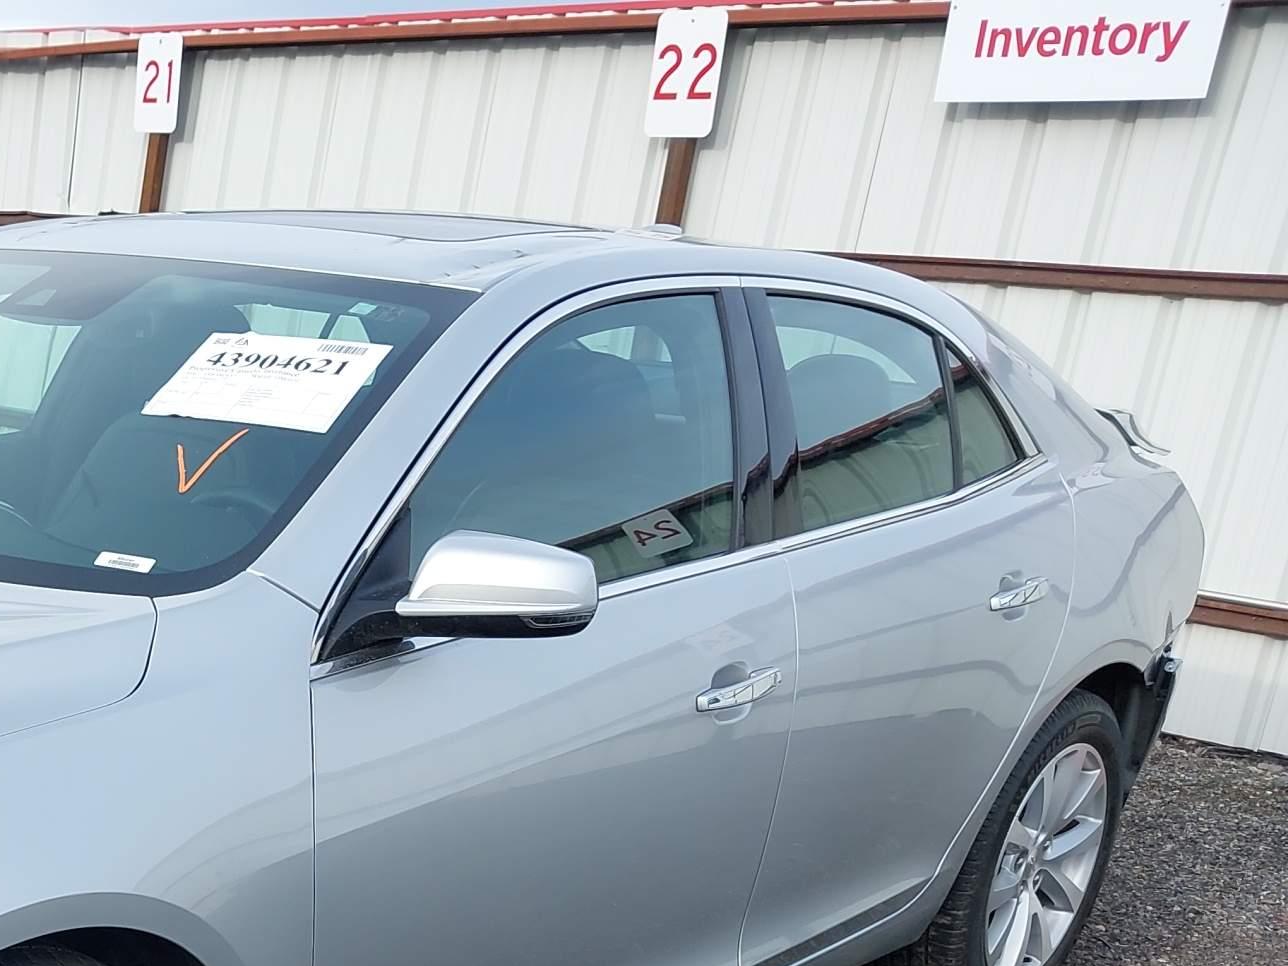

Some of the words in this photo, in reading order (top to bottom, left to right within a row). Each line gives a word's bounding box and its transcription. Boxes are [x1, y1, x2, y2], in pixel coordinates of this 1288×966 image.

[974, 16, 1191, 62] Inventory
[142, 59, 174, 104] 21
[653, 43, 718, 100] 22
[206, 351, 350, 376] 43904621
